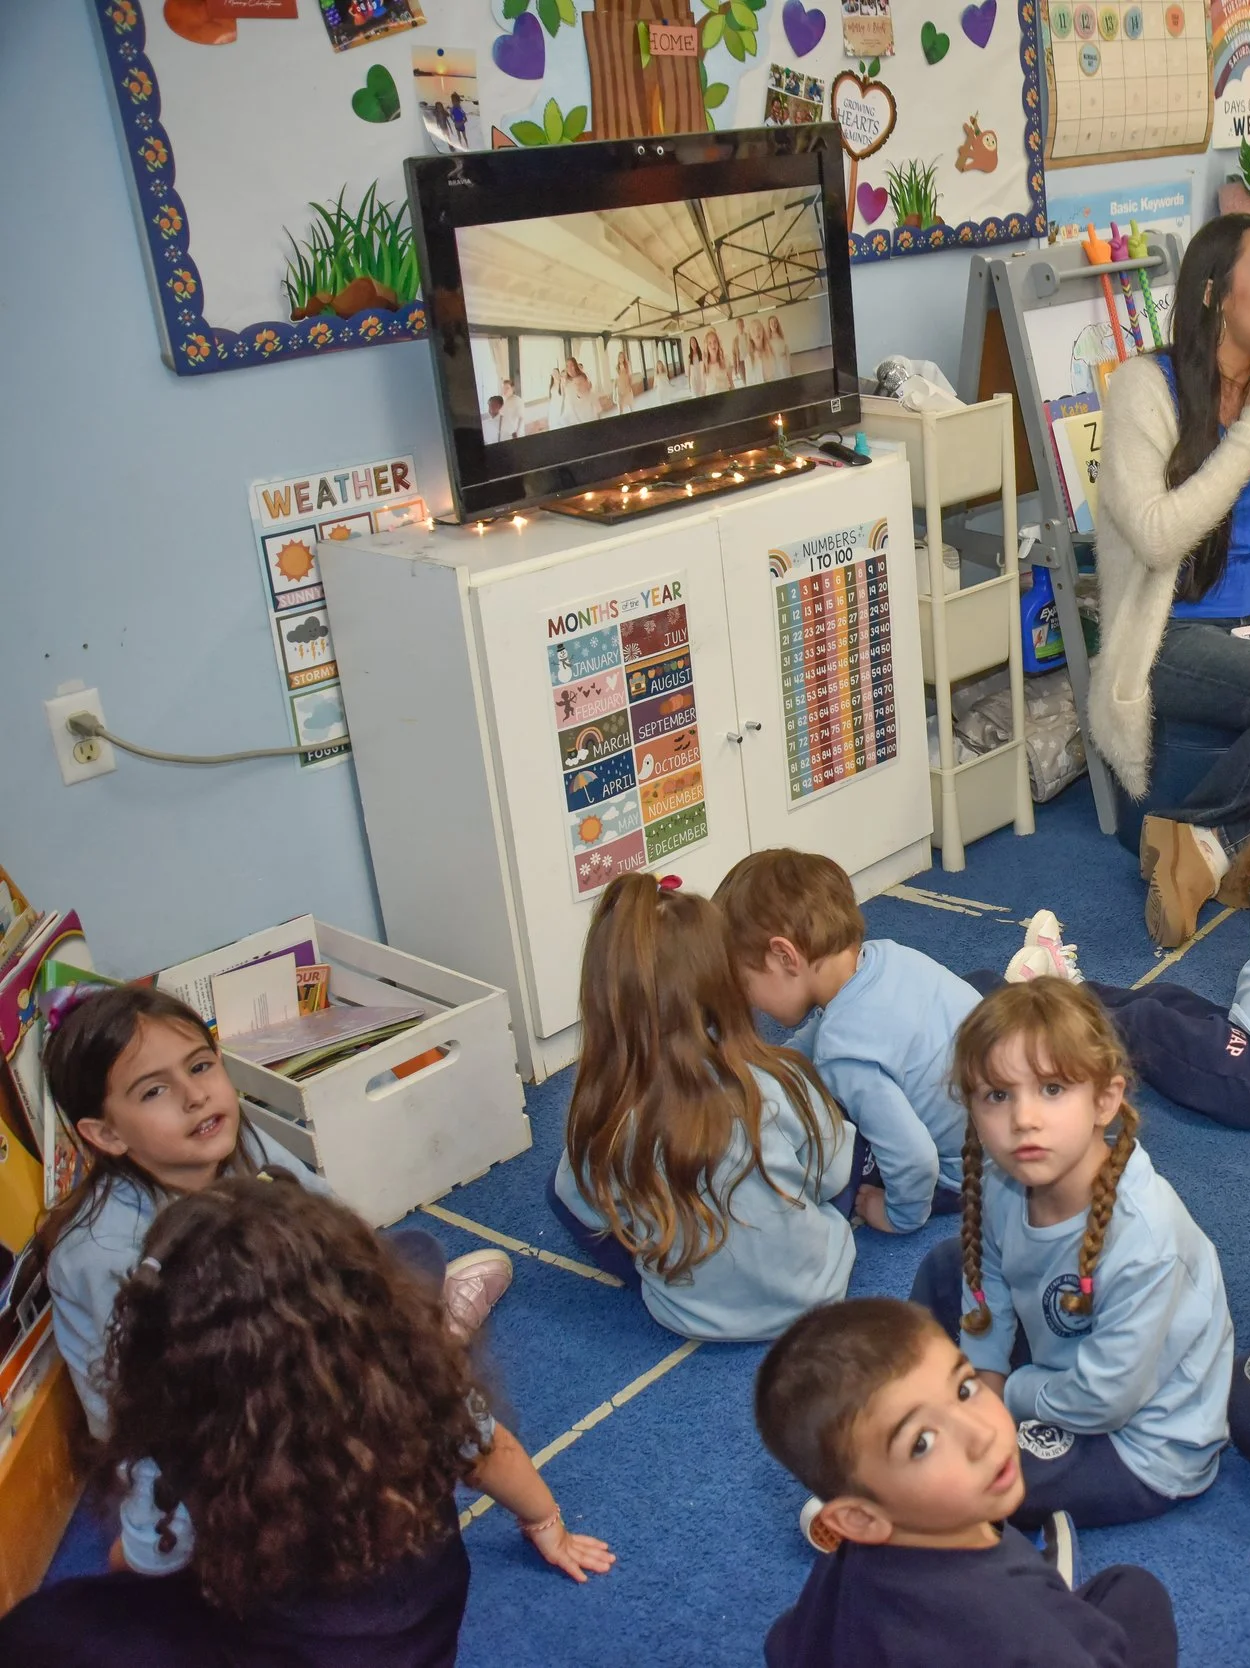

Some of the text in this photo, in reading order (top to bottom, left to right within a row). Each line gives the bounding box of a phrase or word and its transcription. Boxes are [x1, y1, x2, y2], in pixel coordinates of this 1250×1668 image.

[1058, 10, 1140, 30] 11 12 13 14
[650, 32, 694, 50] HOME
[844, 98, 876, 117] GROWING
[1224, 100, 1246, 114] DAYS
[836, 108, 880, 136] HEARTS
[448, 178, 472, 186] BRAVIA
[1110, 193, 1184, 216] Basic Keywords
[1060, 402, 1089, 418] Katie
[667, 440, 695, 454] SONY
[1084, 422, 1101, 452] Z
[262, 460, 411, 520] WEATHER
[802, 530, 857, 558] NUMBERS
[818, 554, 832, 569] TO
[835, 548, 854, 566] 100
[790, 588, 796, 598] 2
[802, 584, 808, 594] 3
[813, 581, 819, 591] 4
[824, 578, 830, 588] 5
[846, 571, 851, 581] 7
[867, 564, 873, 574] 9
[877, 561, 884, 572] 10
[278, 584, 324, 608] SUNNY
[548, 580, 682, 638] MONTHS of the YEAR
[792, 609, 800, 620] 12
[804, 605, 812, 616] 13
[814, 602, 822, 613] 14
[825, 598, 833, 609] 15
[847, 591, 854, 602] 17
[868, 584, 876, 595] 19
[878, 581, 887, 592] 20
[782, 601, 888, 645] 21 22 23 24 25 27 29 30
[664, 628, 688, 647] JULY
[793, 651, 803, 663] 32
[804, 647, 814, 659] 33
[815, 644, 825, 655] 34
[826, 640, 836, 651] 35
[848, 632, 857, 644] 37
[870, 625, 879, 636] 39
[880, 622, 889, 632] 40
[293, 664, 336, 686] STORMY
[573, 650, 619, 677] JANUARY
[793, 672, 804, 684] 42
[805, 668, 815, 679] 43
[816, 664, 826, 675] 44
[827, 661, 837, 671] 45
[848, 653, 858, 664] 47
[870, 645, 880, 656] 49
[880, 642, 890, 653] 50
[650, 668, 691, 694] AUGUST
[785, 662, 891, 709] 51 52 53 54 55 57 59 60
[575, 693, 626, 722] FEBRUARY
[787, 719, 794, 730] 61
[808, 711, 818, 722] 63
[818, 707, 829, 718] 64
[851, 694, 860, 705] 67
[872, 686, 882, 697] 69
[883, 683, 892, 693] 70
[638, 708, 696, 740] SEPTEMBER
[788, 703, 894, 751] 71 72 73 74 77 79 80
[592, 732, 631, 758] MARCH
[790, 723, 895, 773] 81 82 83 84 85 87 89 90
[654, 746, 700, 775] OCTOBER
[792, 743, 896, 792] 91 92 93 94 95 97 99 100
[602, 774, 635, 798] APRIL
[648, 784, 704, 818] NOVEMBER
[618, 812, 640, 832] MAY
[656, 822, 707, 856] DECEMBER
[617, 850, 645, 875] JUNE
